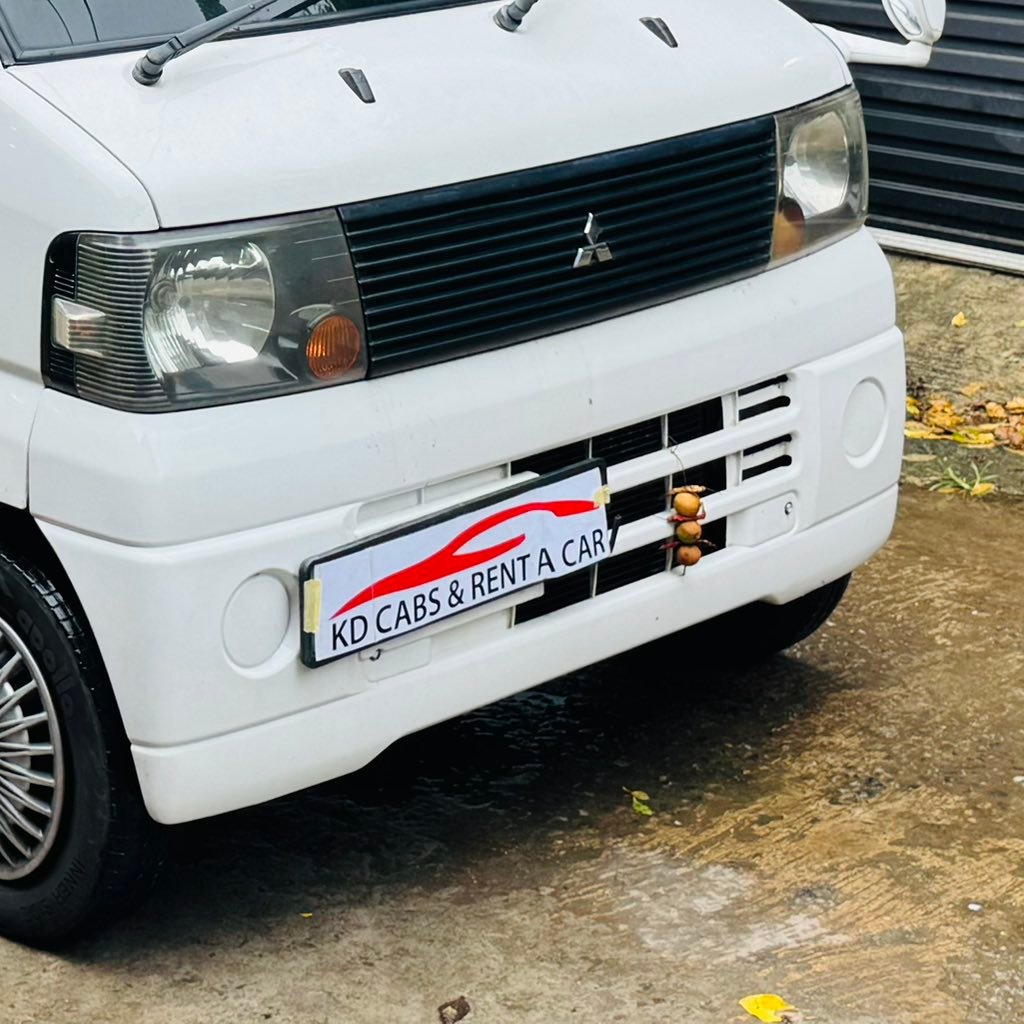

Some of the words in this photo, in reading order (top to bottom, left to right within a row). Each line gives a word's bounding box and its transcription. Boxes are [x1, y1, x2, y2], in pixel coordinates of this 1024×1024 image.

[332, 614, 368, 651] KD
[376, 586, 441, 634] CABS
[448, 580, 465, 608] &
[471, 553, 532, 601] RENT
[537, 547, 556, 576] A
[561, 528, 607, 567] CAR
[15, 608, 74, 721] apollo
